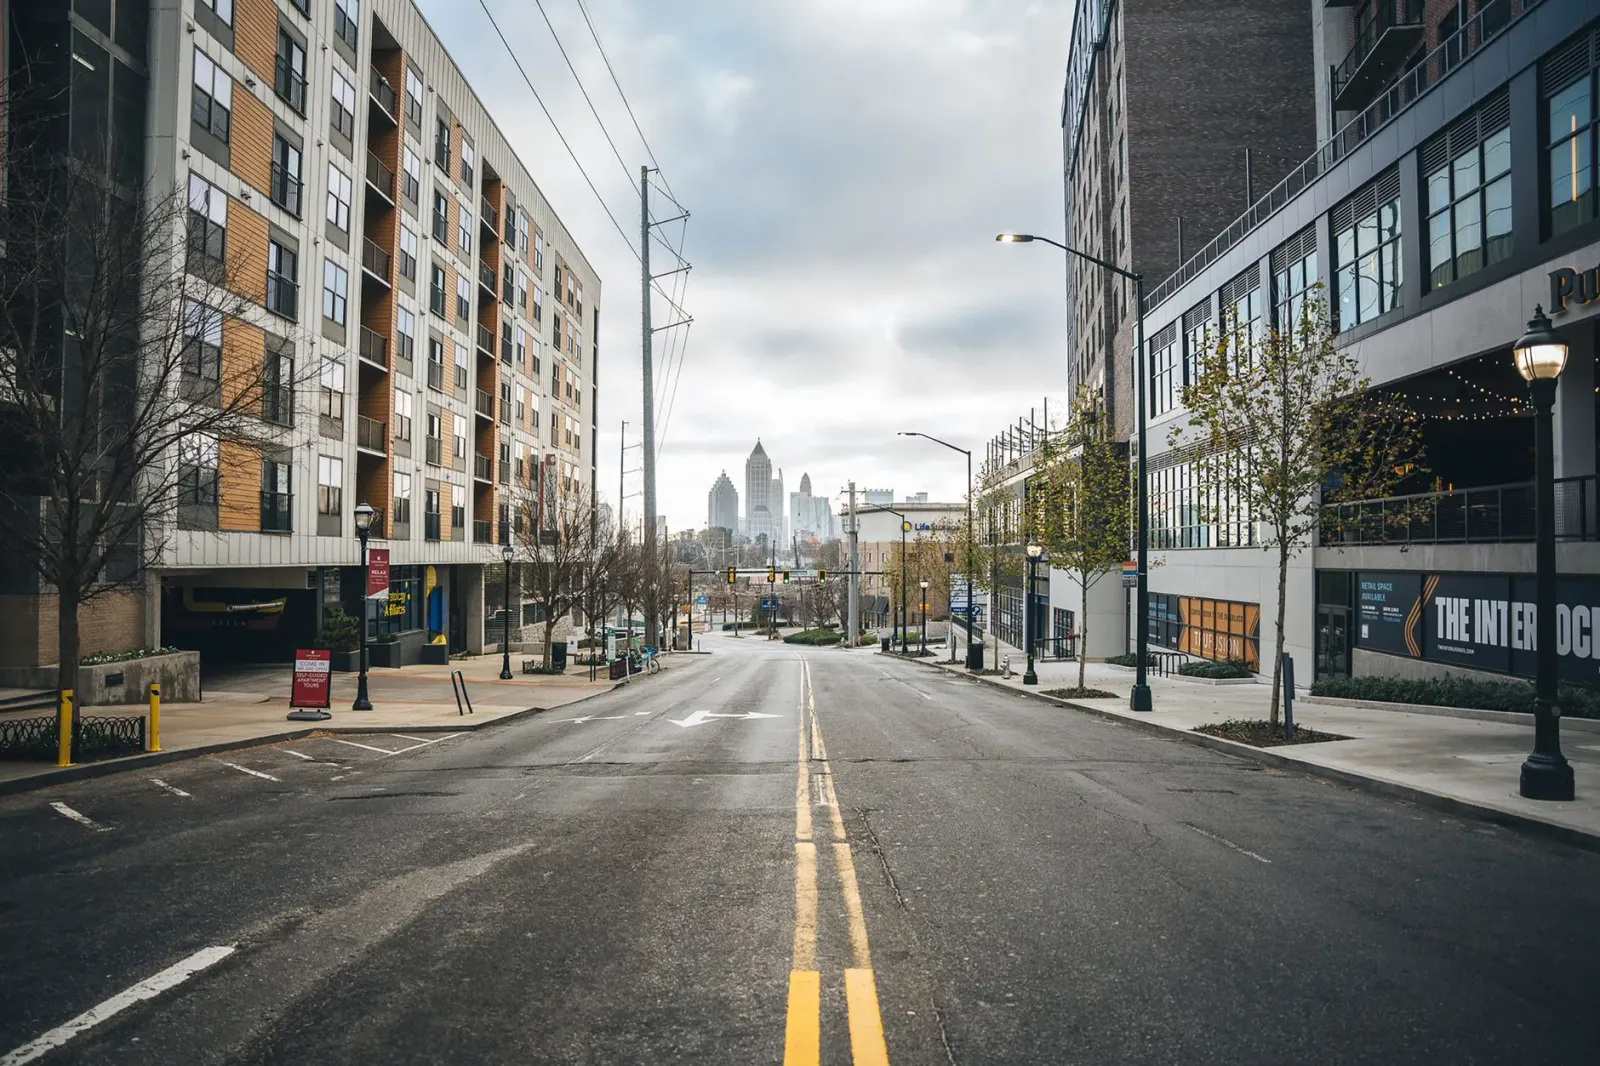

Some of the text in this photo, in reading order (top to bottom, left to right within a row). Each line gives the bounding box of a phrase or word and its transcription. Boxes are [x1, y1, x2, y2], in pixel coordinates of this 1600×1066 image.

[1361, 582, 1393, 591] RETAIL SPACE
[1361, 592, 1386, 602] AVAILABLE
[1435, 597, 1600, 660] THE INTEROC
